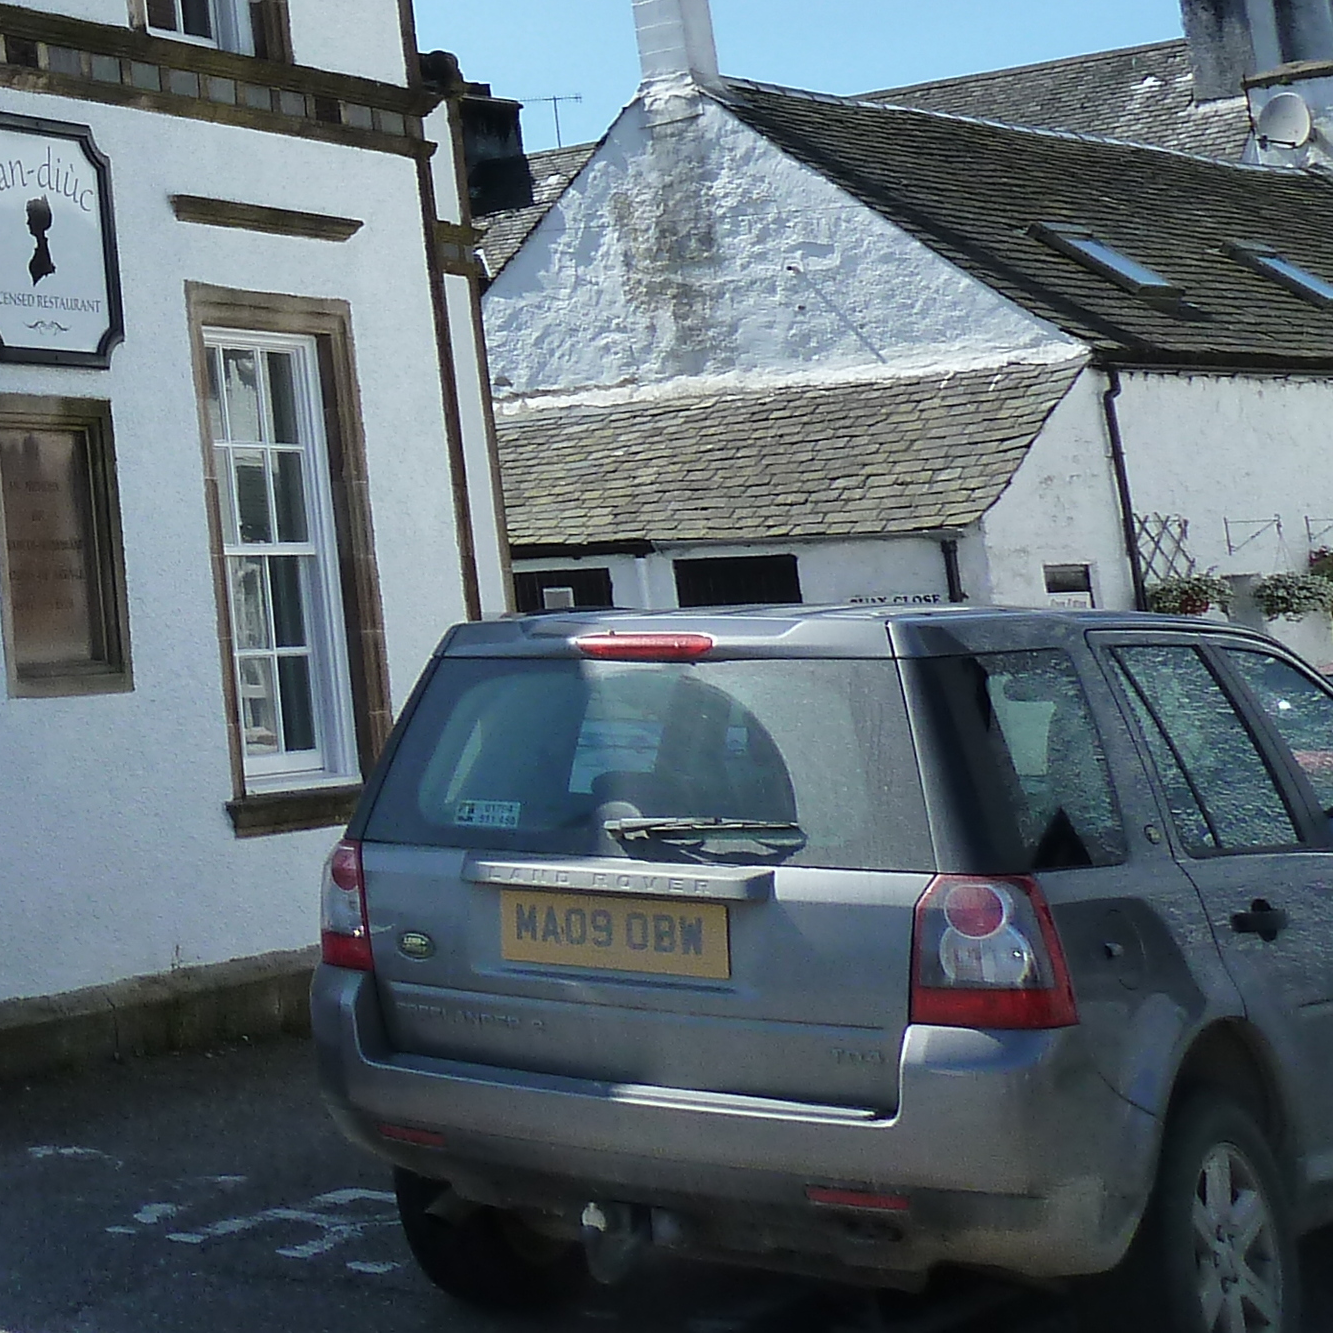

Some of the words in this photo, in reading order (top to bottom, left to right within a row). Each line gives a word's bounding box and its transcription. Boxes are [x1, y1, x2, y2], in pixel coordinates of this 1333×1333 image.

[36, 294, 101, 313] RESTAURANT
[487, 866, 569, 885] LAND
[592, 873, 710, 894] ROVER
[516, 903, 613, 949] MA09
[625, 912, 703, 956] OBW
